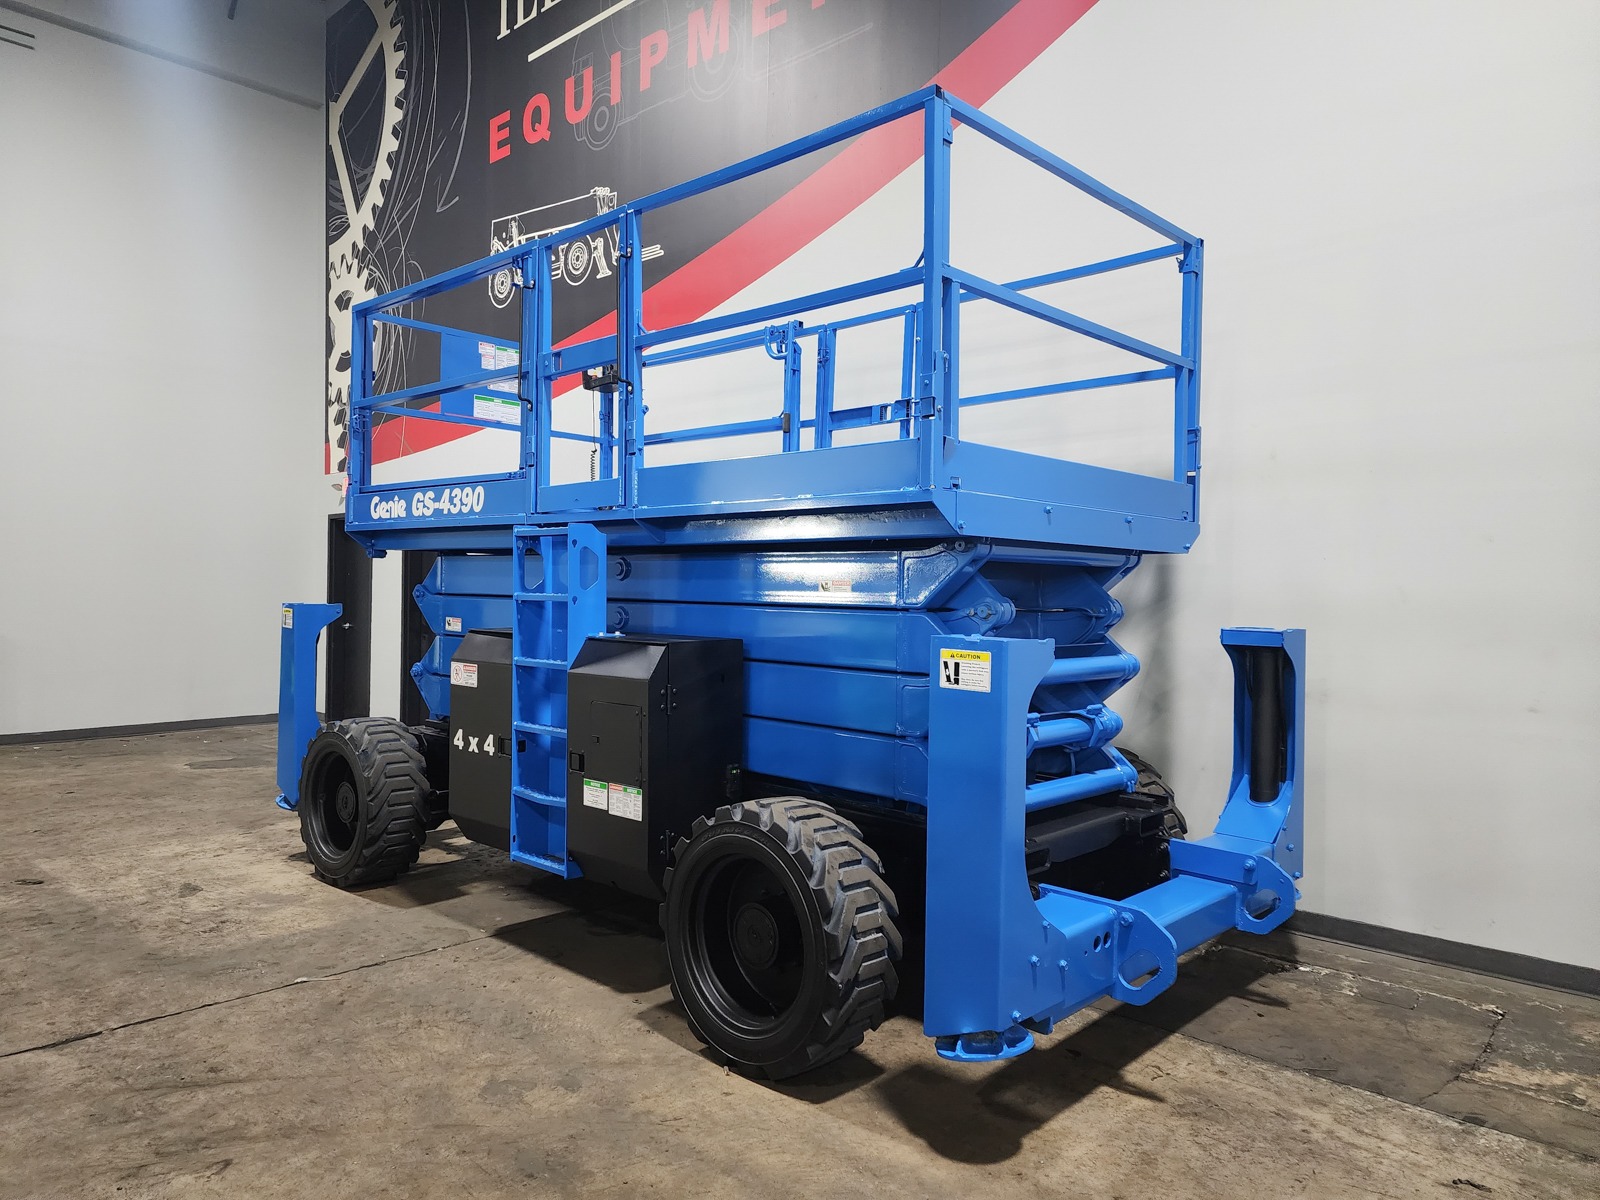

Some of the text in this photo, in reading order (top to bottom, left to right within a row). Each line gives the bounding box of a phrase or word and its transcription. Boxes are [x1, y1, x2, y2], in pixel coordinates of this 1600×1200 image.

[490, 0, 826, 164] EQUIPME
[371, 485, 485, 520] Genie GS-4390
[453, 728, 495, 757] 4 x 4
